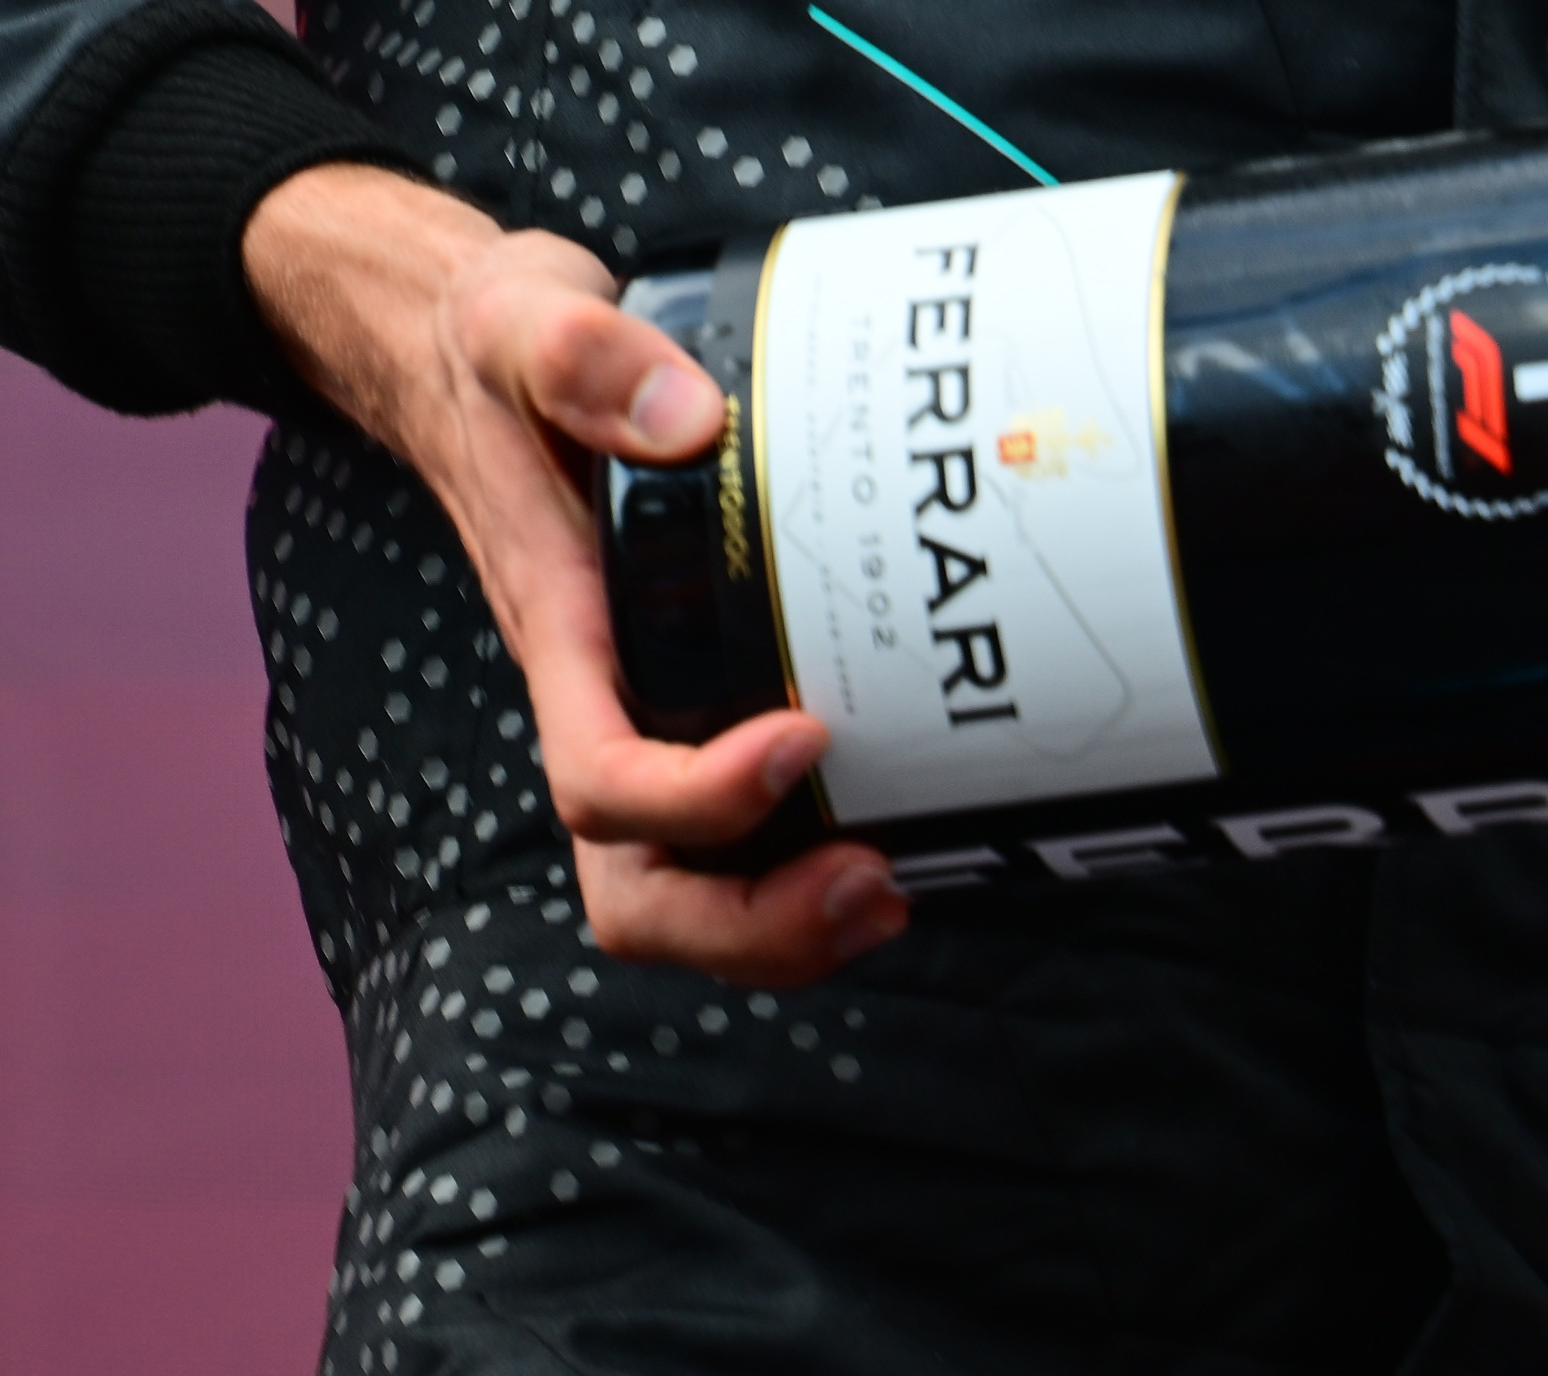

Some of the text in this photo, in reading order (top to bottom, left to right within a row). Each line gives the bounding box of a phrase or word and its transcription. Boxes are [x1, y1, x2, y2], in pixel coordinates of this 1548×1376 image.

[845, 310, 900, 652] TRENTO 1902
[905, 242, 1020, 730] FERRARI
